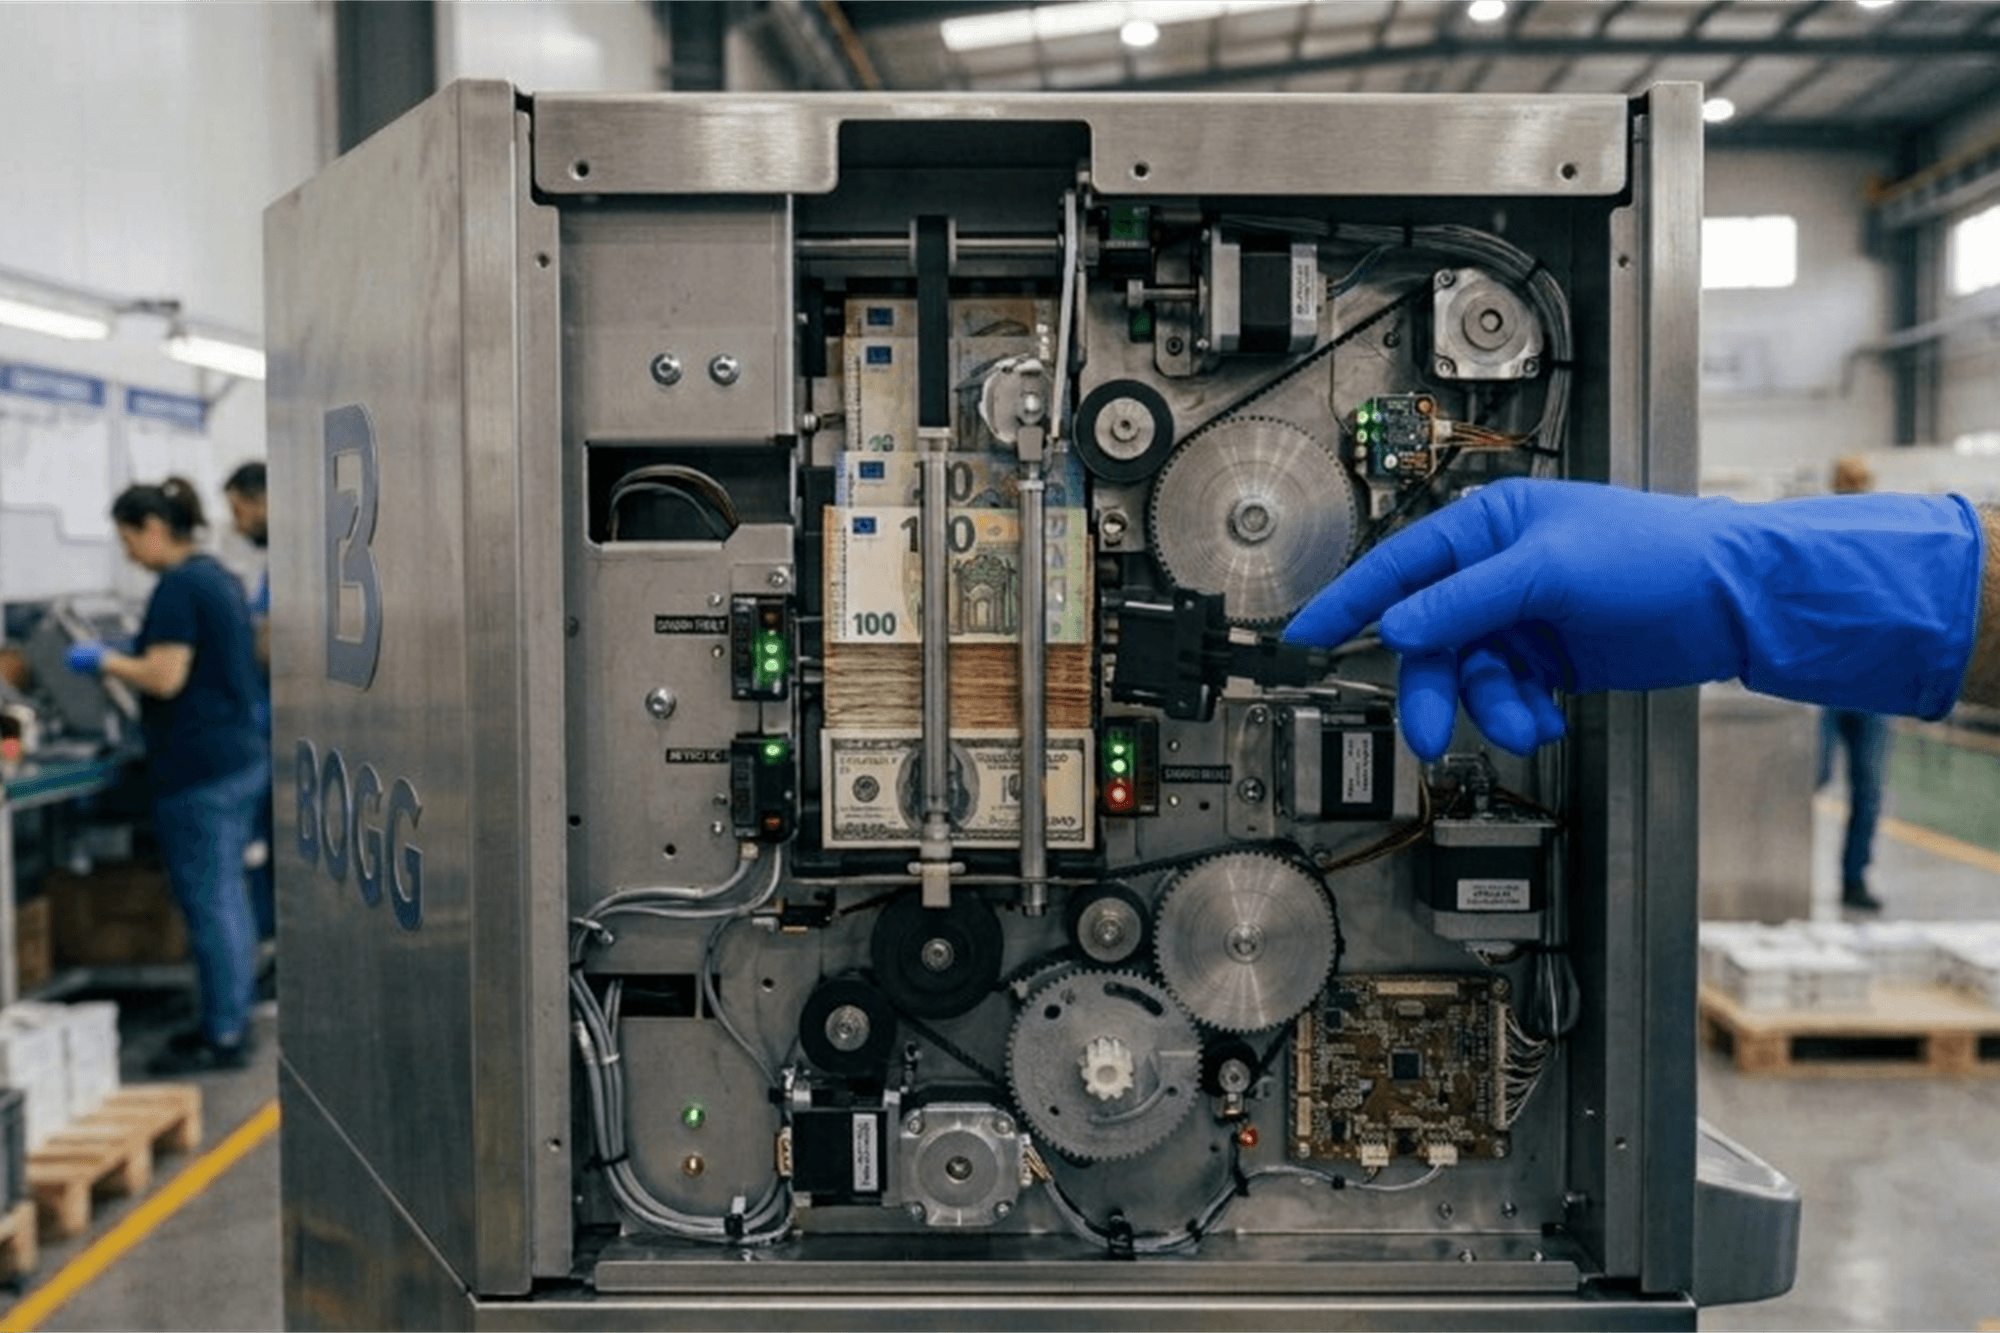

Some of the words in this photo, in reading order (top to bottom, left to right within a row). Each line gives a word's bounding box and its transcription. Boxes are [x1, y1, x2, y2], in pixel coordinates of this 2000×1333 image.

[900, 515, 977, 554] 10
[852, 612, 897, 636] 100
[296, 737, 424, 932] BOGG
